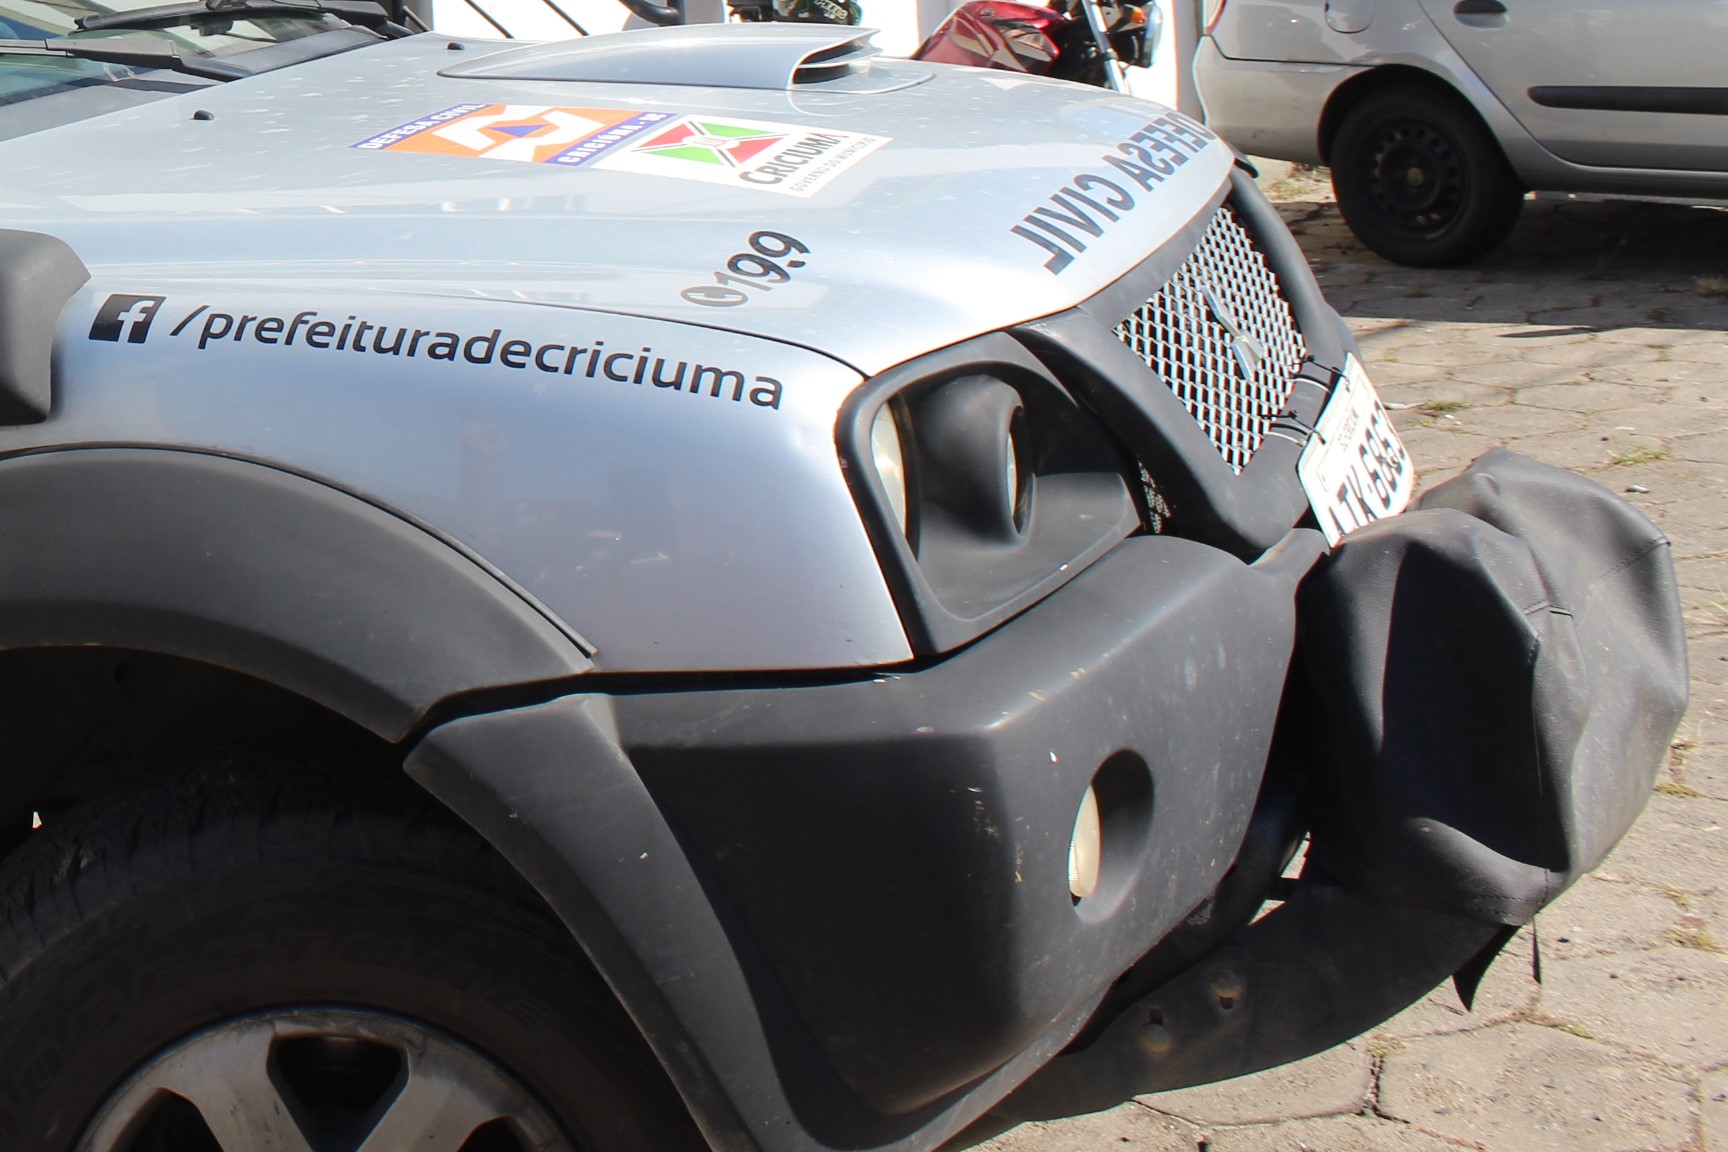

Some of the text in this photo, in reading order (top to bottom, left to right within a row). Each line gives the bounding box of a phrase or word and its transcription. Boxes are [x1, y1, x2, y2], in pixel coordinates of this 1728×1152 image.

[355, 104, 487, 149] DEFESA CIVIL
[713, 231, 811, 292] 199
[170, 305, 785, 410] /prefeituradecriciuma
